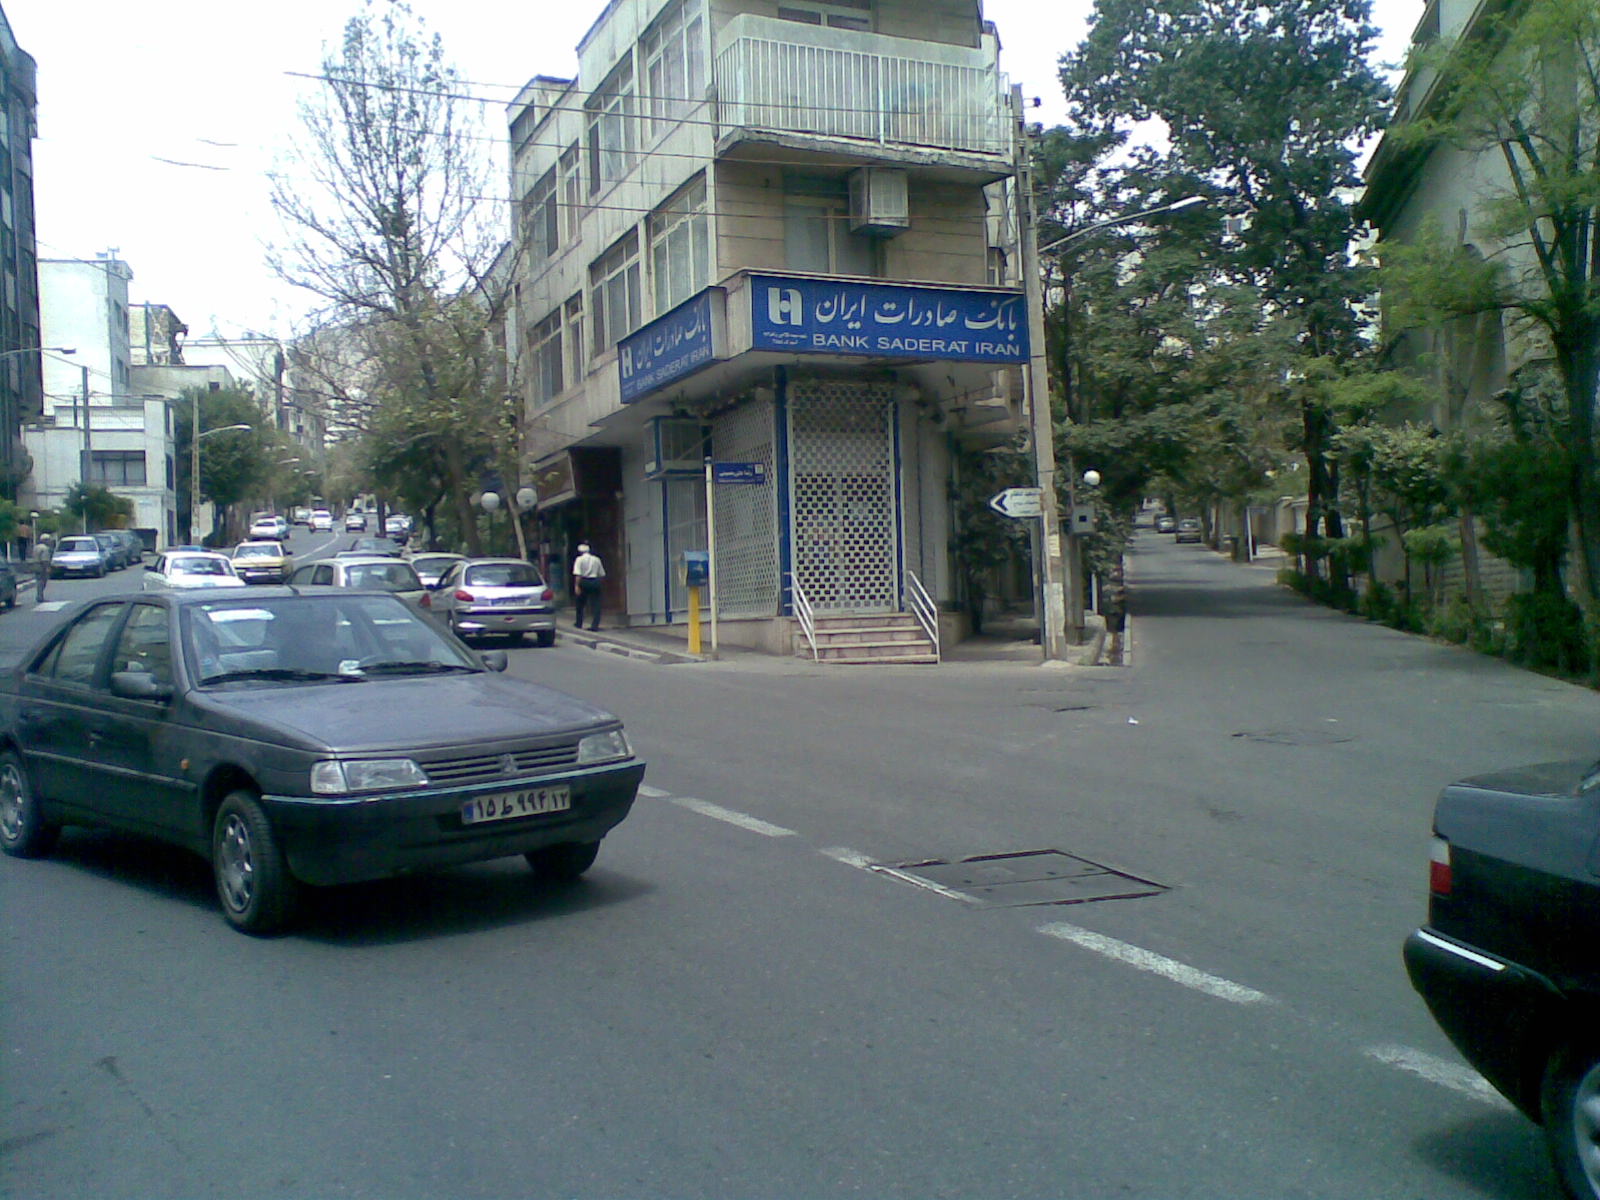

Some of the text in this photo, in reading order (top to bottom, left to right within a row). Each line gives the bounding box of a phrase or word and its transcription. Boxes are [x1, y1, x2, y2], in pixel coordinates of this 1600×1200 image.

[815, 291, 1021, 341] بانک صادرات ایران
[812, 333, 869, 349] BANK
[877, 336, 968, 354] SADERAT
[975, 341, 1020, 356] IRAN
